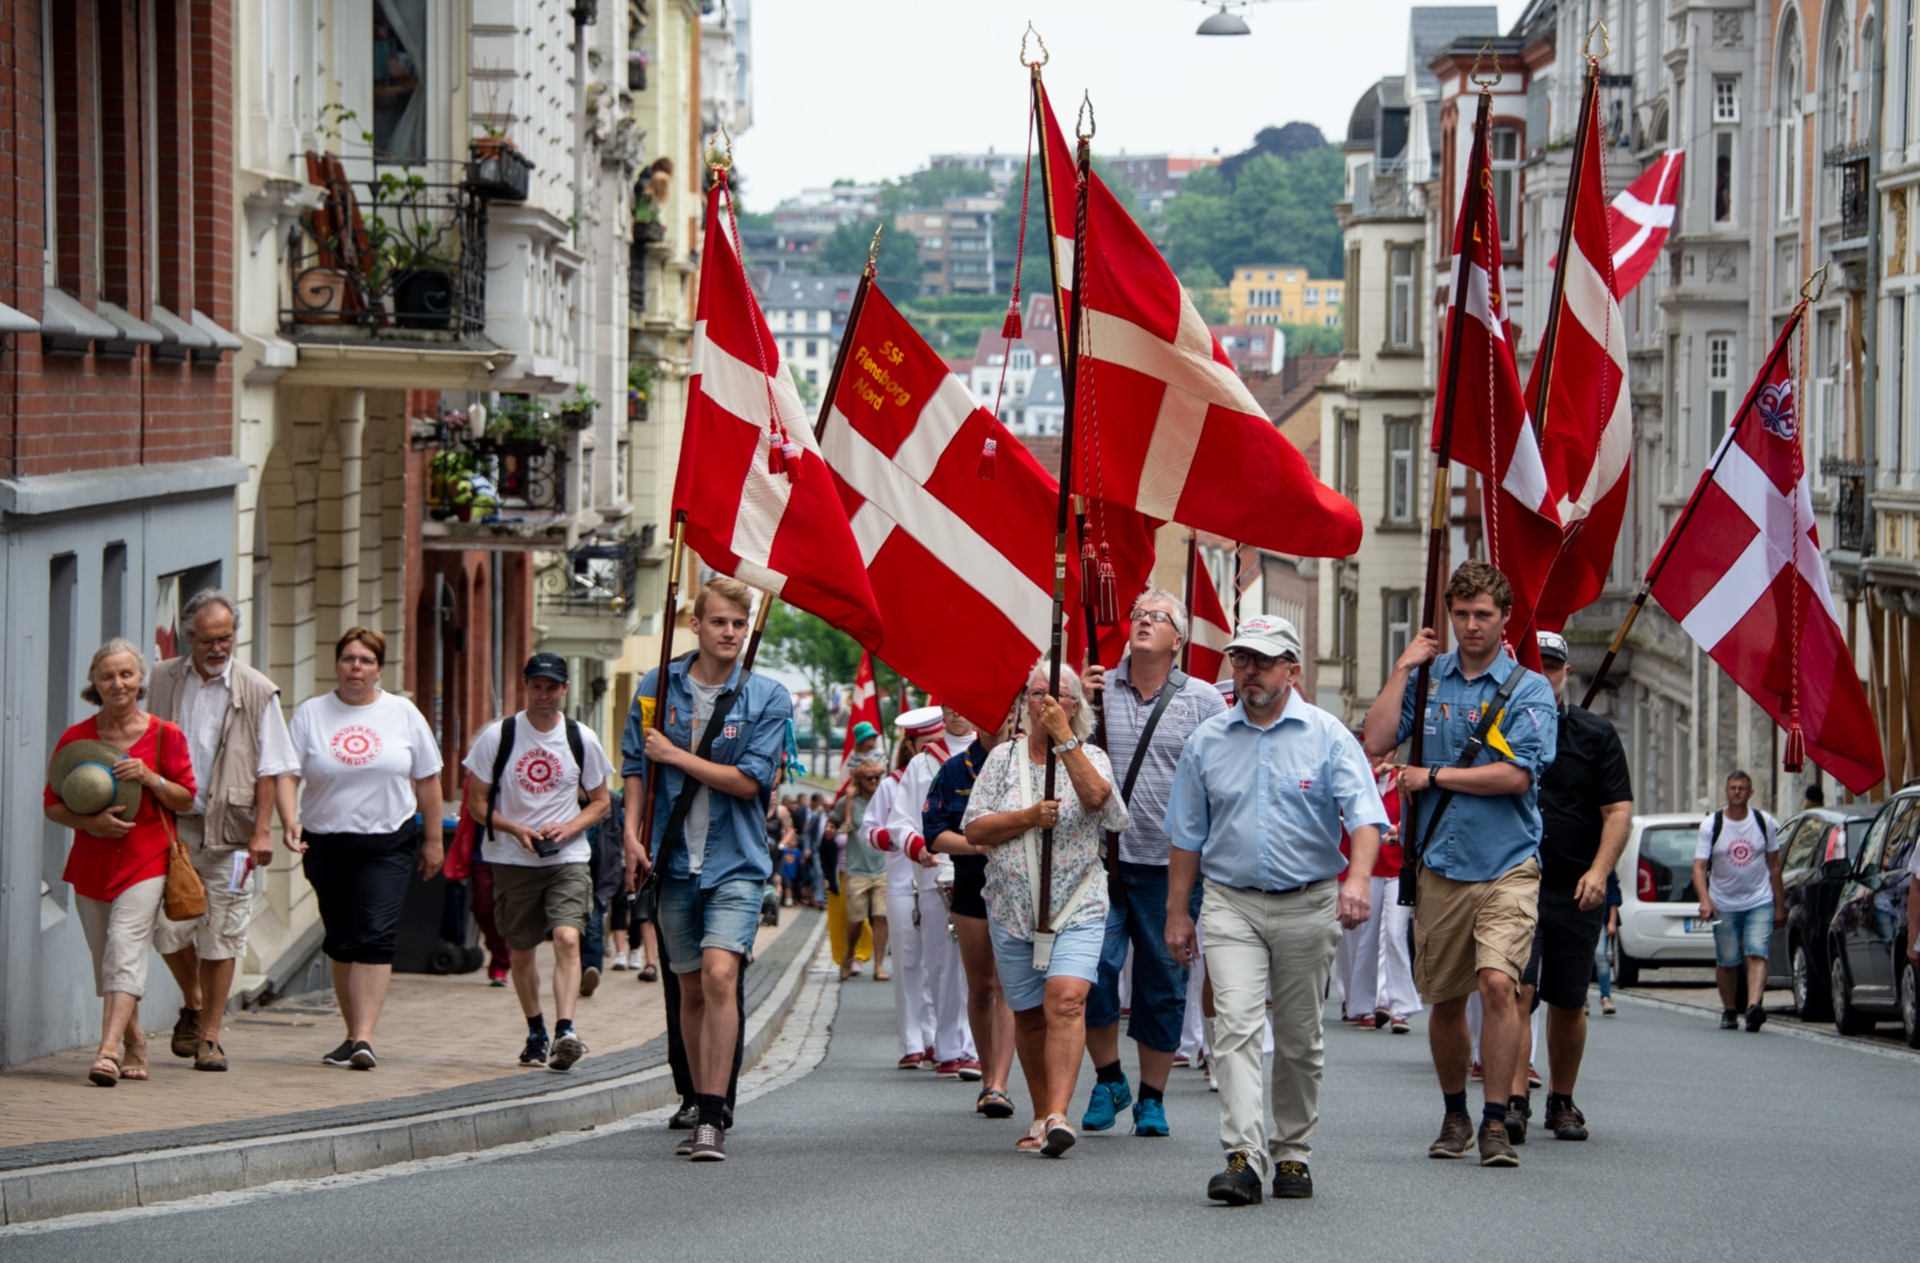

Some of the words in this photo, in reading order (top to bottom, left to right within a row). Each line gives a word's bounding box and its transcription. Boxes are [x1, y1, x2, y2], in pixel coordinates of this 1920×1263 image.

[854, 345, 911, 407] Flensborg
[851, 376, 885, 412] Nord
[335, 751, 375, 766] GARDEN
[519, 778, 556, 794] GARDEN
